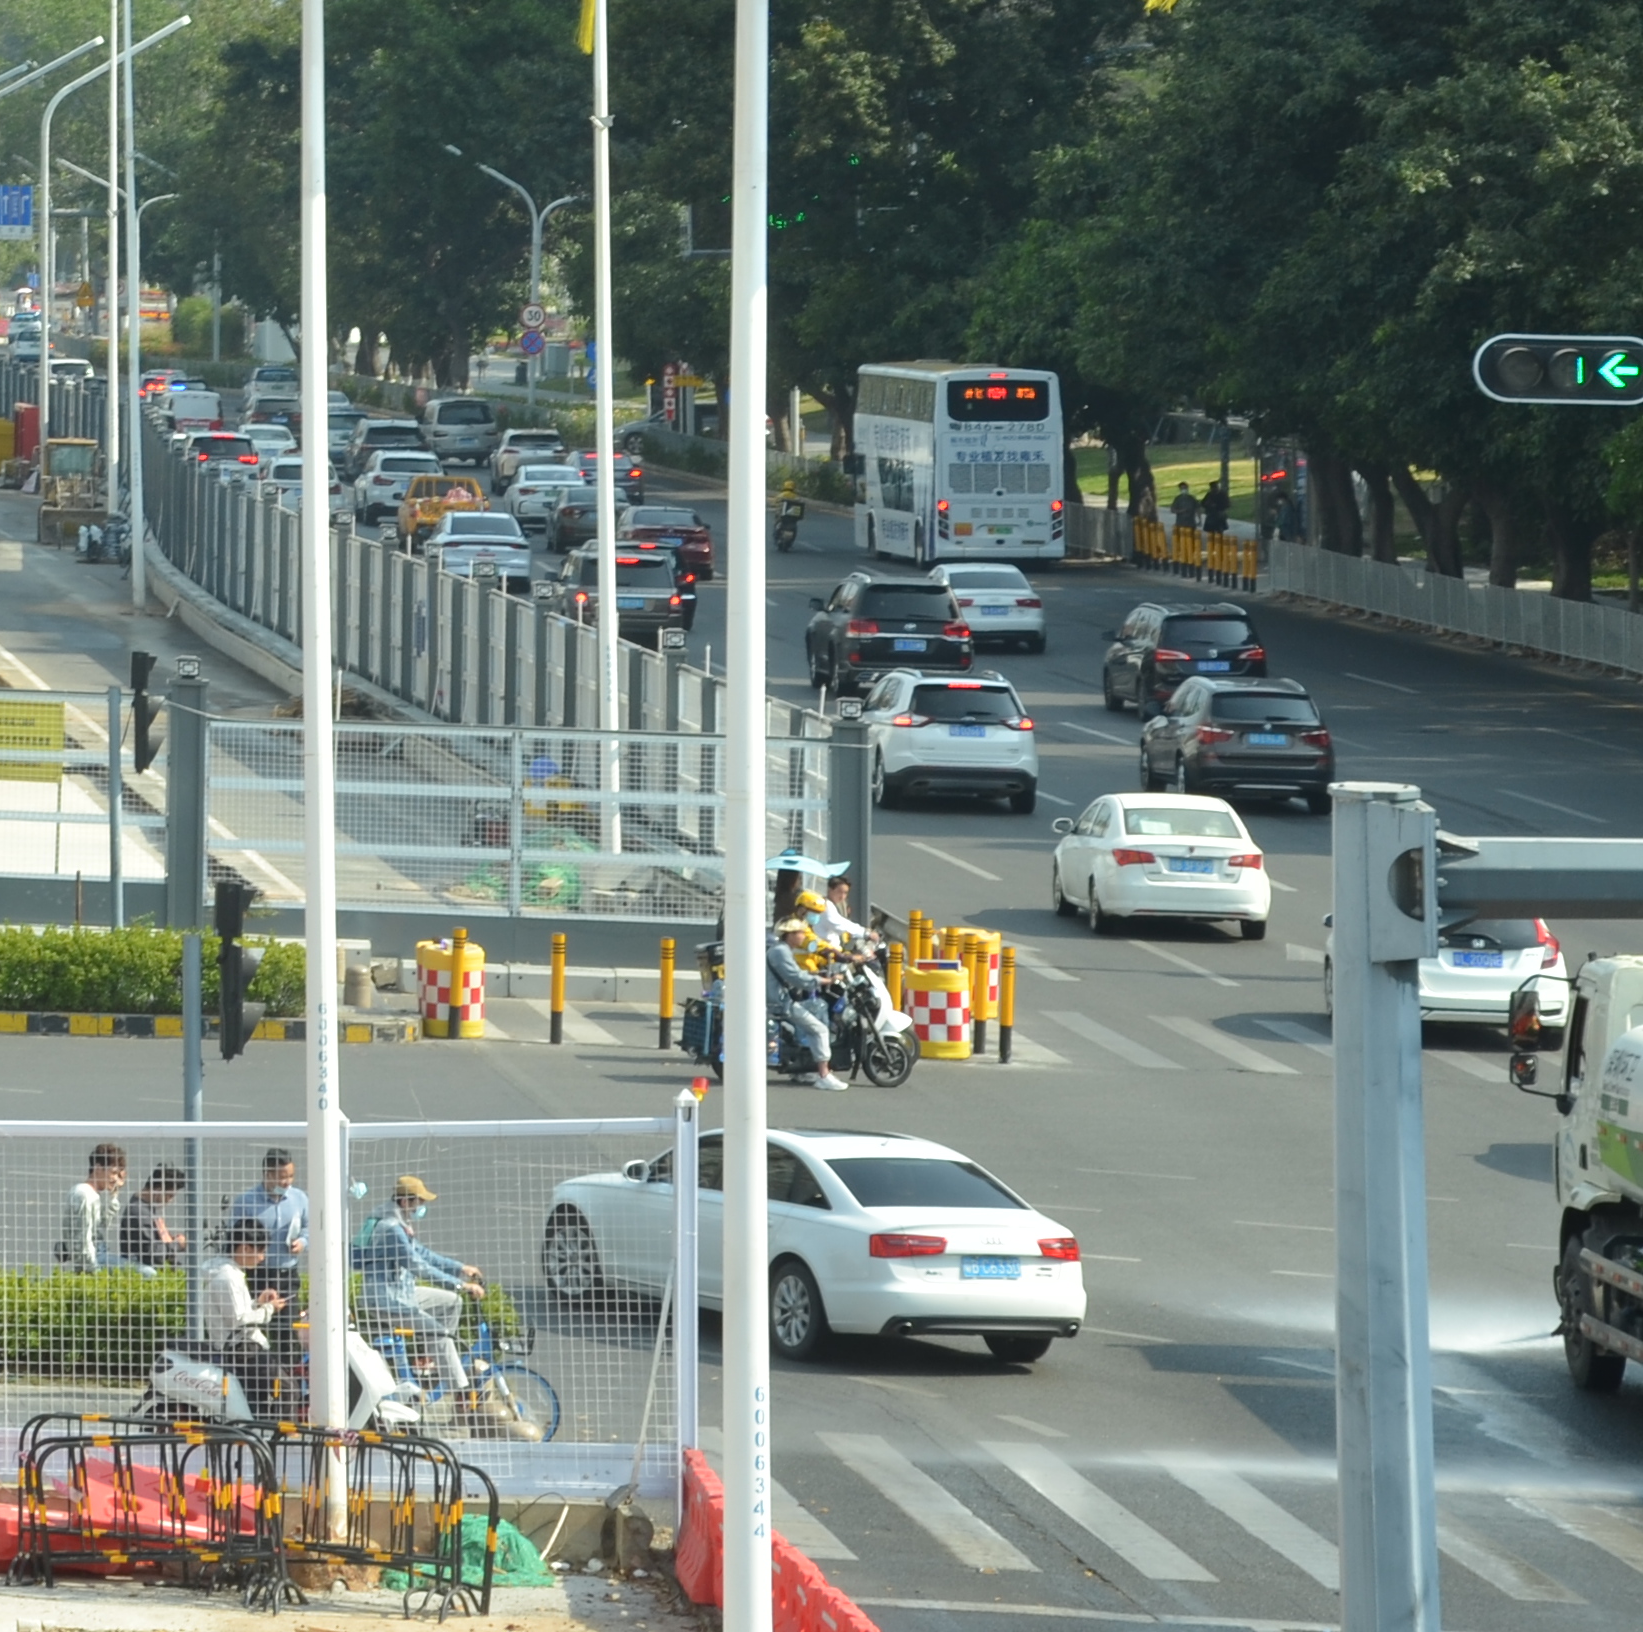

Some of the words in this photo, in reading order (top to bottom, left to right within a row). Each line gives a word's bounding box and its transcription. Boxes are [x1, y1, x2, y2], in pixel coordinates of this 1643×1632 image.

[527, 309, 542, 322] 30
[317, 1002, 328, 1110] 6006340
[753, 1386, 765, 1538] 6006344
